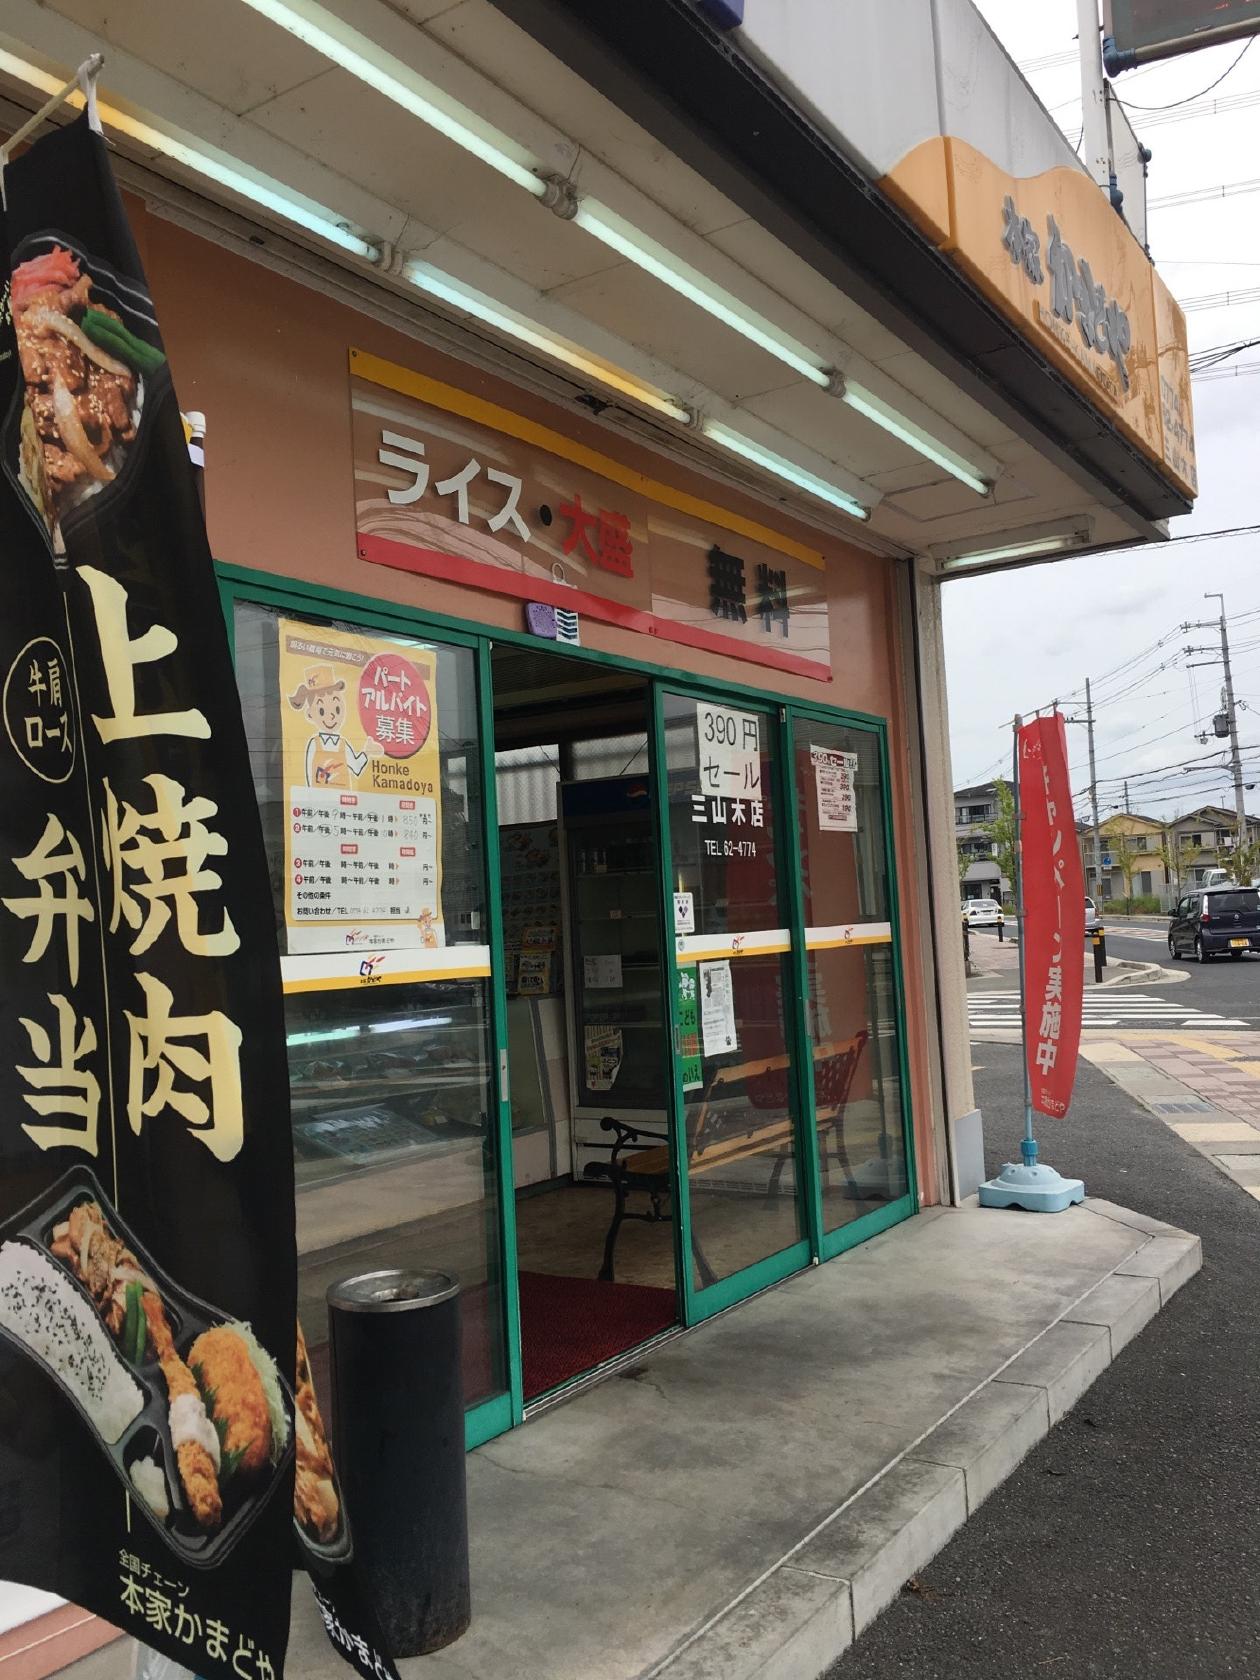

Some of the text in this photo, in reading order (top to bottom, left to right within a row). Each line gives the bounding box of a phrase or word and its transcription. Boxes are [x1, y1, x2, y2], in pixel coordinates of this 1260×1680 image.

[708, 544, 790, 638] 無料
[27, 657, 62, 708] 牛肩
[374, 666, 411, 691] パート
[361, 688, 427, 717] アルバイト
[25, 716, 71, 751] ロース
[375, 714, 415, 745] 募集
[372, 759, 410, 776] Honke
[704, 756, 760, 790] セール
[372, 775, 434, 795] Kamadoya
[692, 794, 764, 828] 三山木店
[76, 564, 244, 1163] 上焼肉
[704, 840, 757, 857] TEL 62-4774
[1, 813, 101, 1158] 弁当
[119, 1548, 190, 1598] 全国チェーン
[119, 1574, 275, 1680] 本家かまどや
